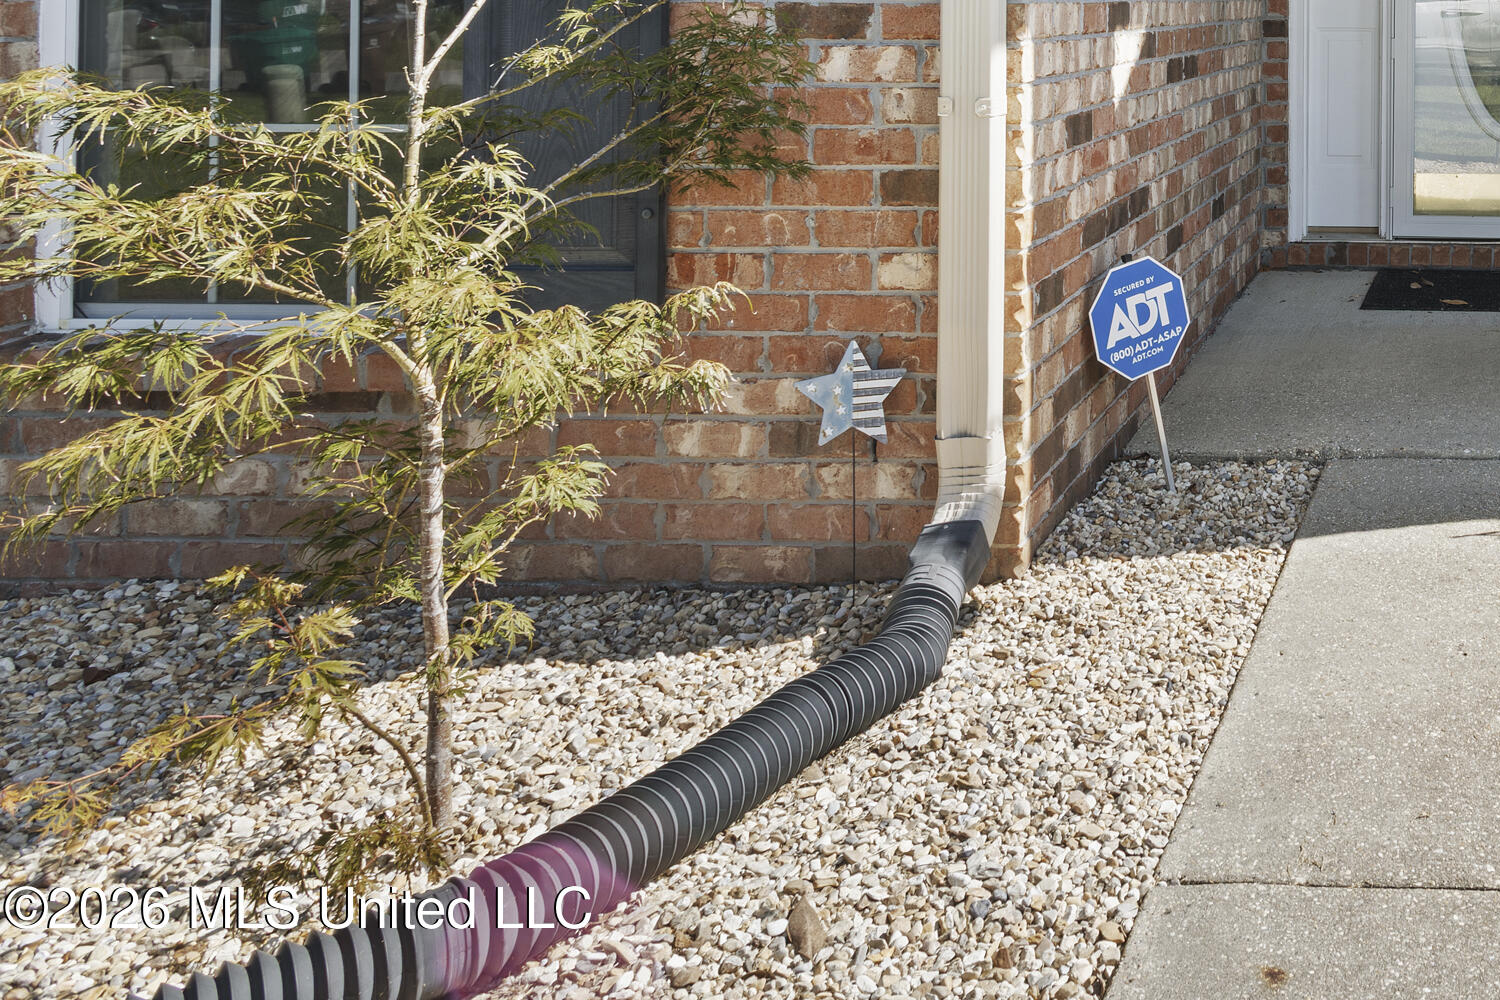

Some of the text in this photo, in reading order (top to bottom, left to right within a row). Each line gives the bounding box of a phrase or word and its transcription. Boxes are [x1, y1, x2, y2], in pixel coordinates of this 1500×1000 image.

[1113, 275, 1155, 297] SECURED BY
[1106, 281, 1174, 350] ADT
[1110, 326, 1183, 364] (800) ADT-ASAP
[1132, 346, 1164, 364] ADT.COM
